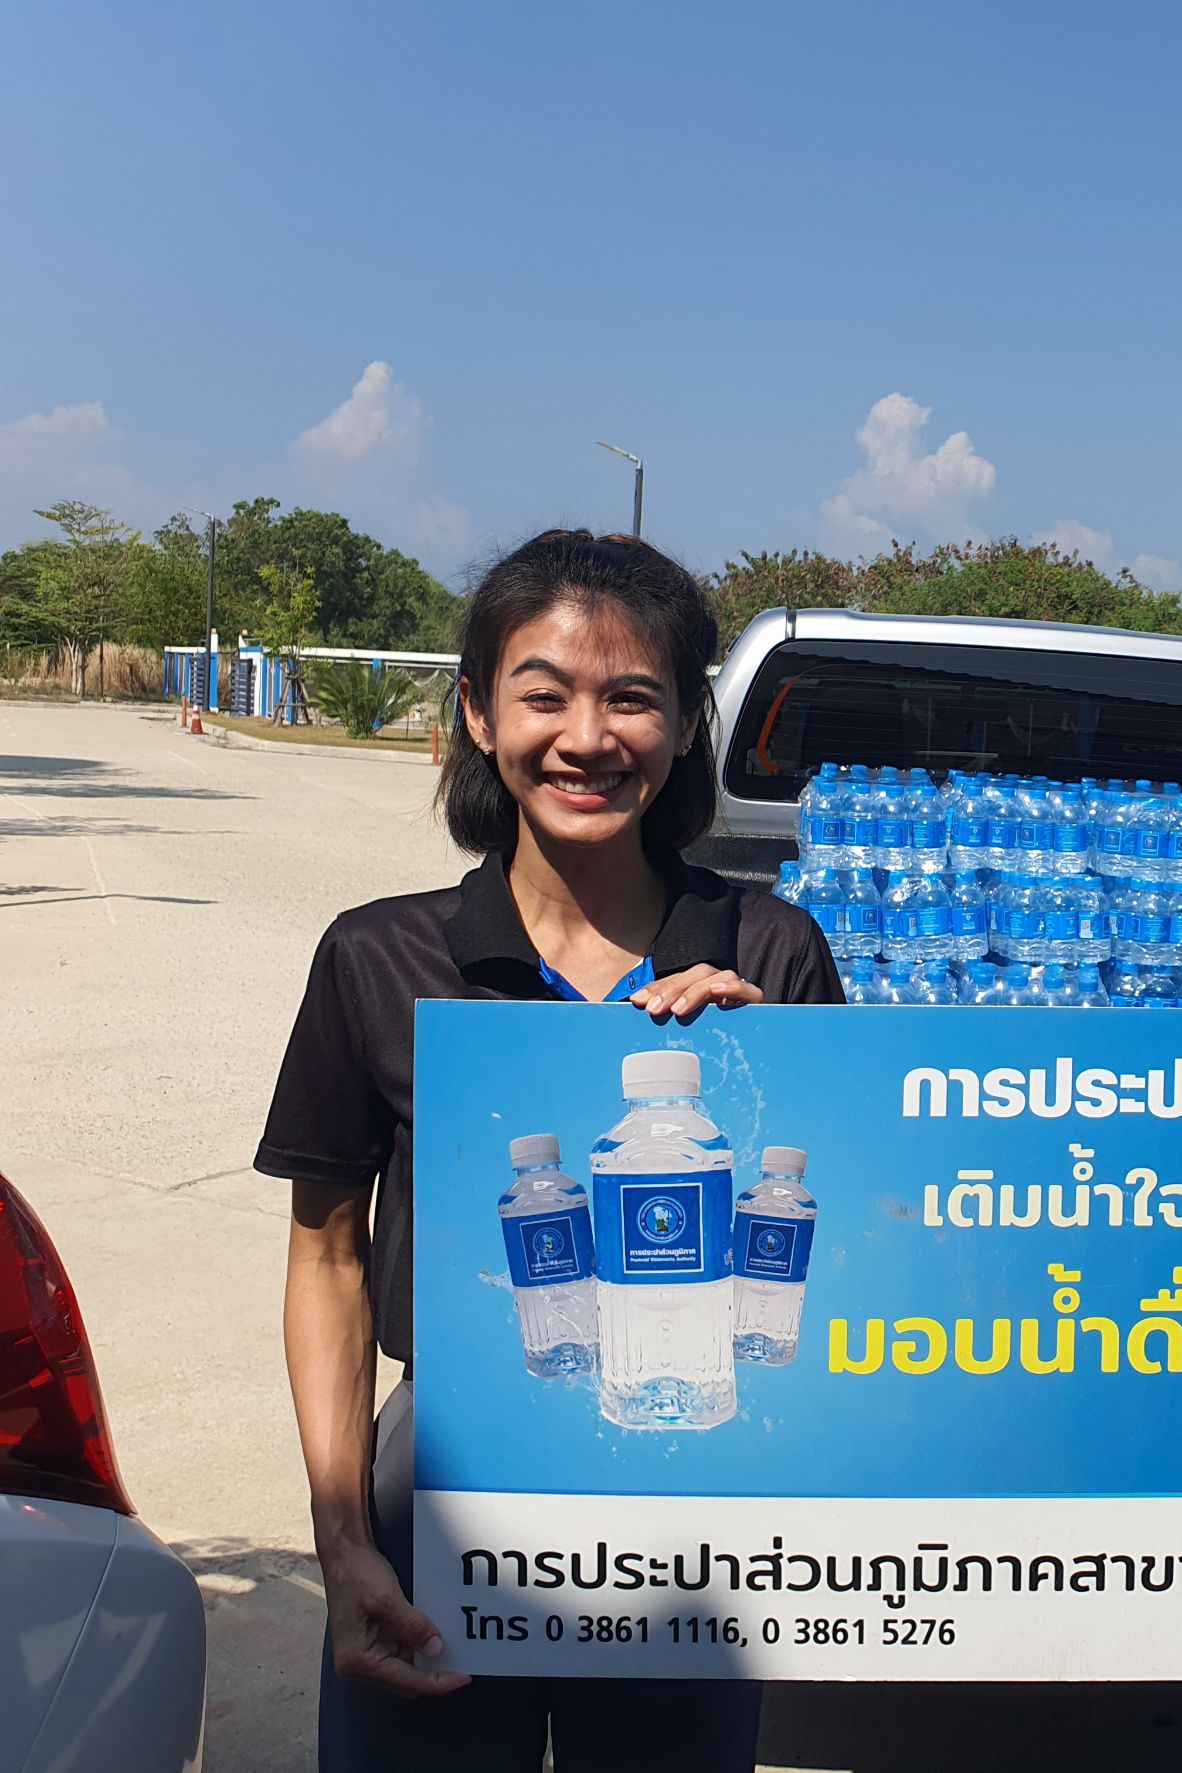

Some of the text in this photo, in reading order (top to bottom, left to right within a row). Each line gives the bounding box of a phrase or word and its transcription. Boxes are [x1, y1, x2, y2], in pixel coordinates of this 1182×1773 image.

[459, 1605, 956, 1649] โทร 0 3861 1116, 0 3861 5276
